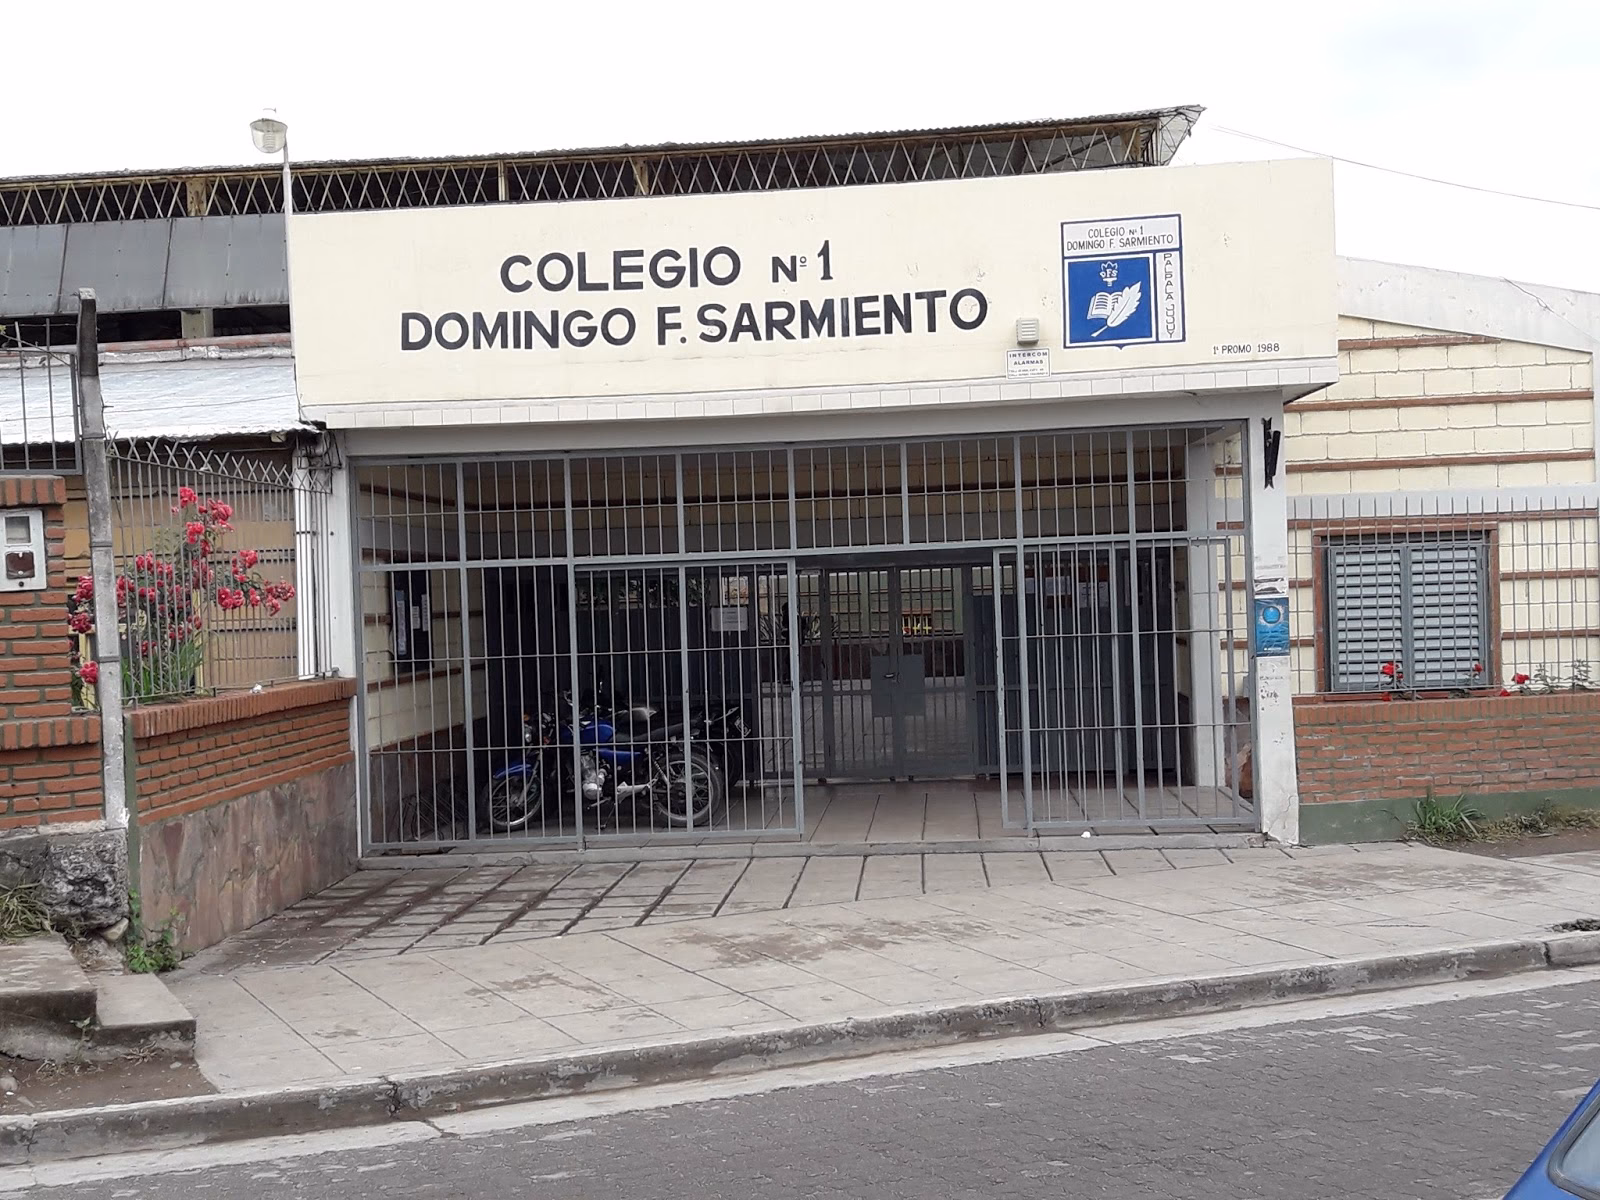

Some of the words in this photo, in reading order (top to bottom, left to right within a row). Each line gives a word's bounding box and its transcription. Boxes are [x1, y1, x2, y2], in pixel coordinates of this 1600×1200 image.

[1088, 227, 1125, 239] COLEGIO
[1140, 225, 1144, 235] 1
[1066, 240, 1105, 251] DOMINGO
[1109, 239, 1116, 249] F.
[1119, 234, 1174, 248] SARMIENTO
[500, 246, 741, 293] COLEGIO
[817, 240, 834, 281] 1
[400, 307, 636, 351] DOMINGO
[657, 306, 688, 346] F.
[698, 288, 989, 343] SARMIENTO
[1221, 344, 1252, 354] PROMO
[1257, 342, 1280, 353] 1988
